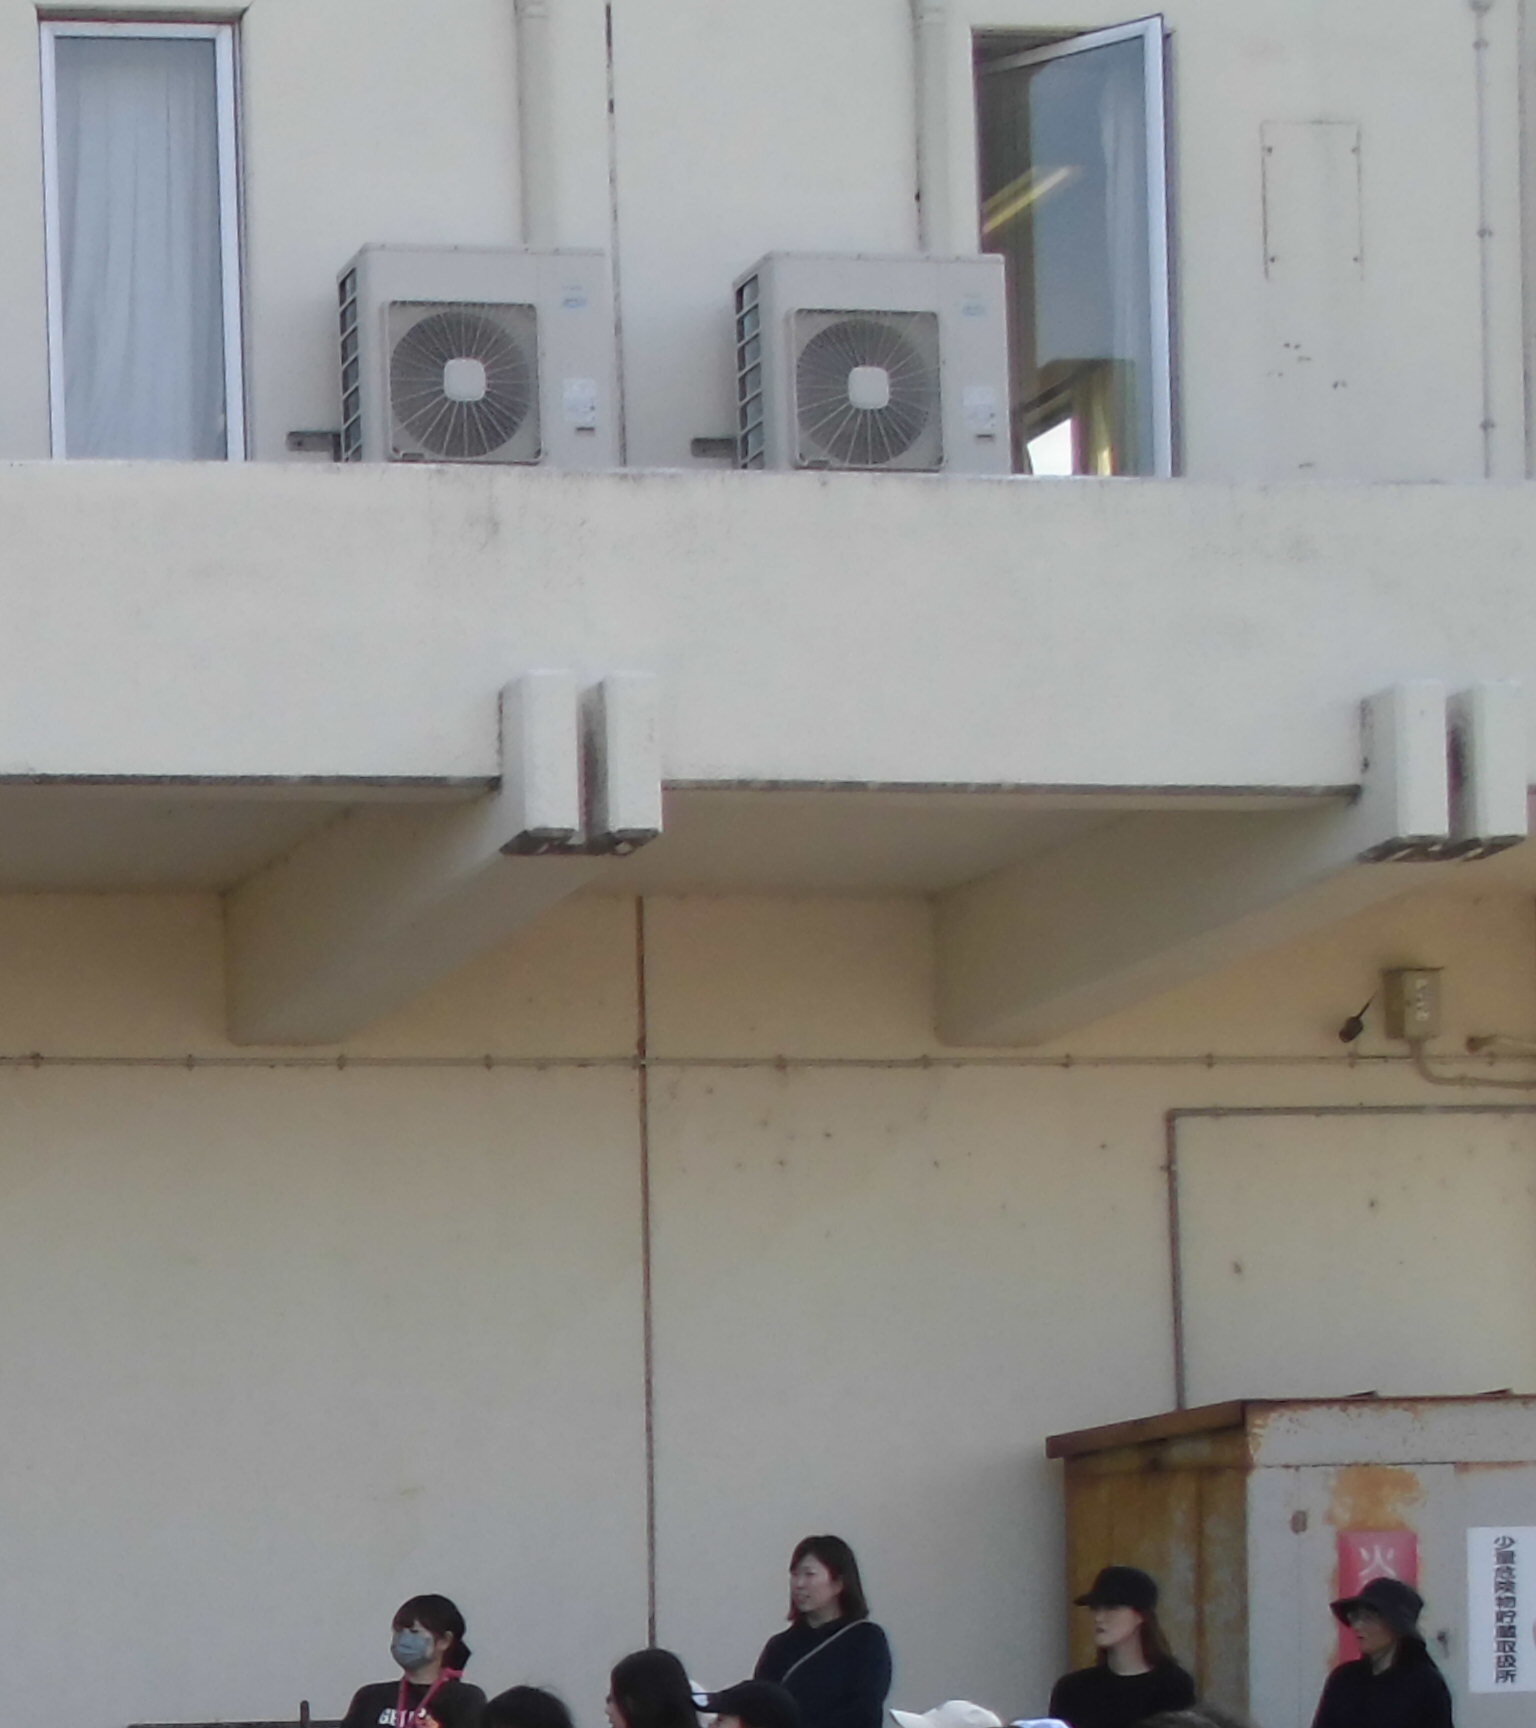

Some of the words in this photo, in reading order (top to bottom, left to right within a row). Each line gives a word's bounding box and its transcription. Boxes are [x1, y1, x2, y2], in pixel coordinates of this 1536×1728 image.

[1493, 1535, 1517, 1684] 少量危険物貯蔵取扱所
